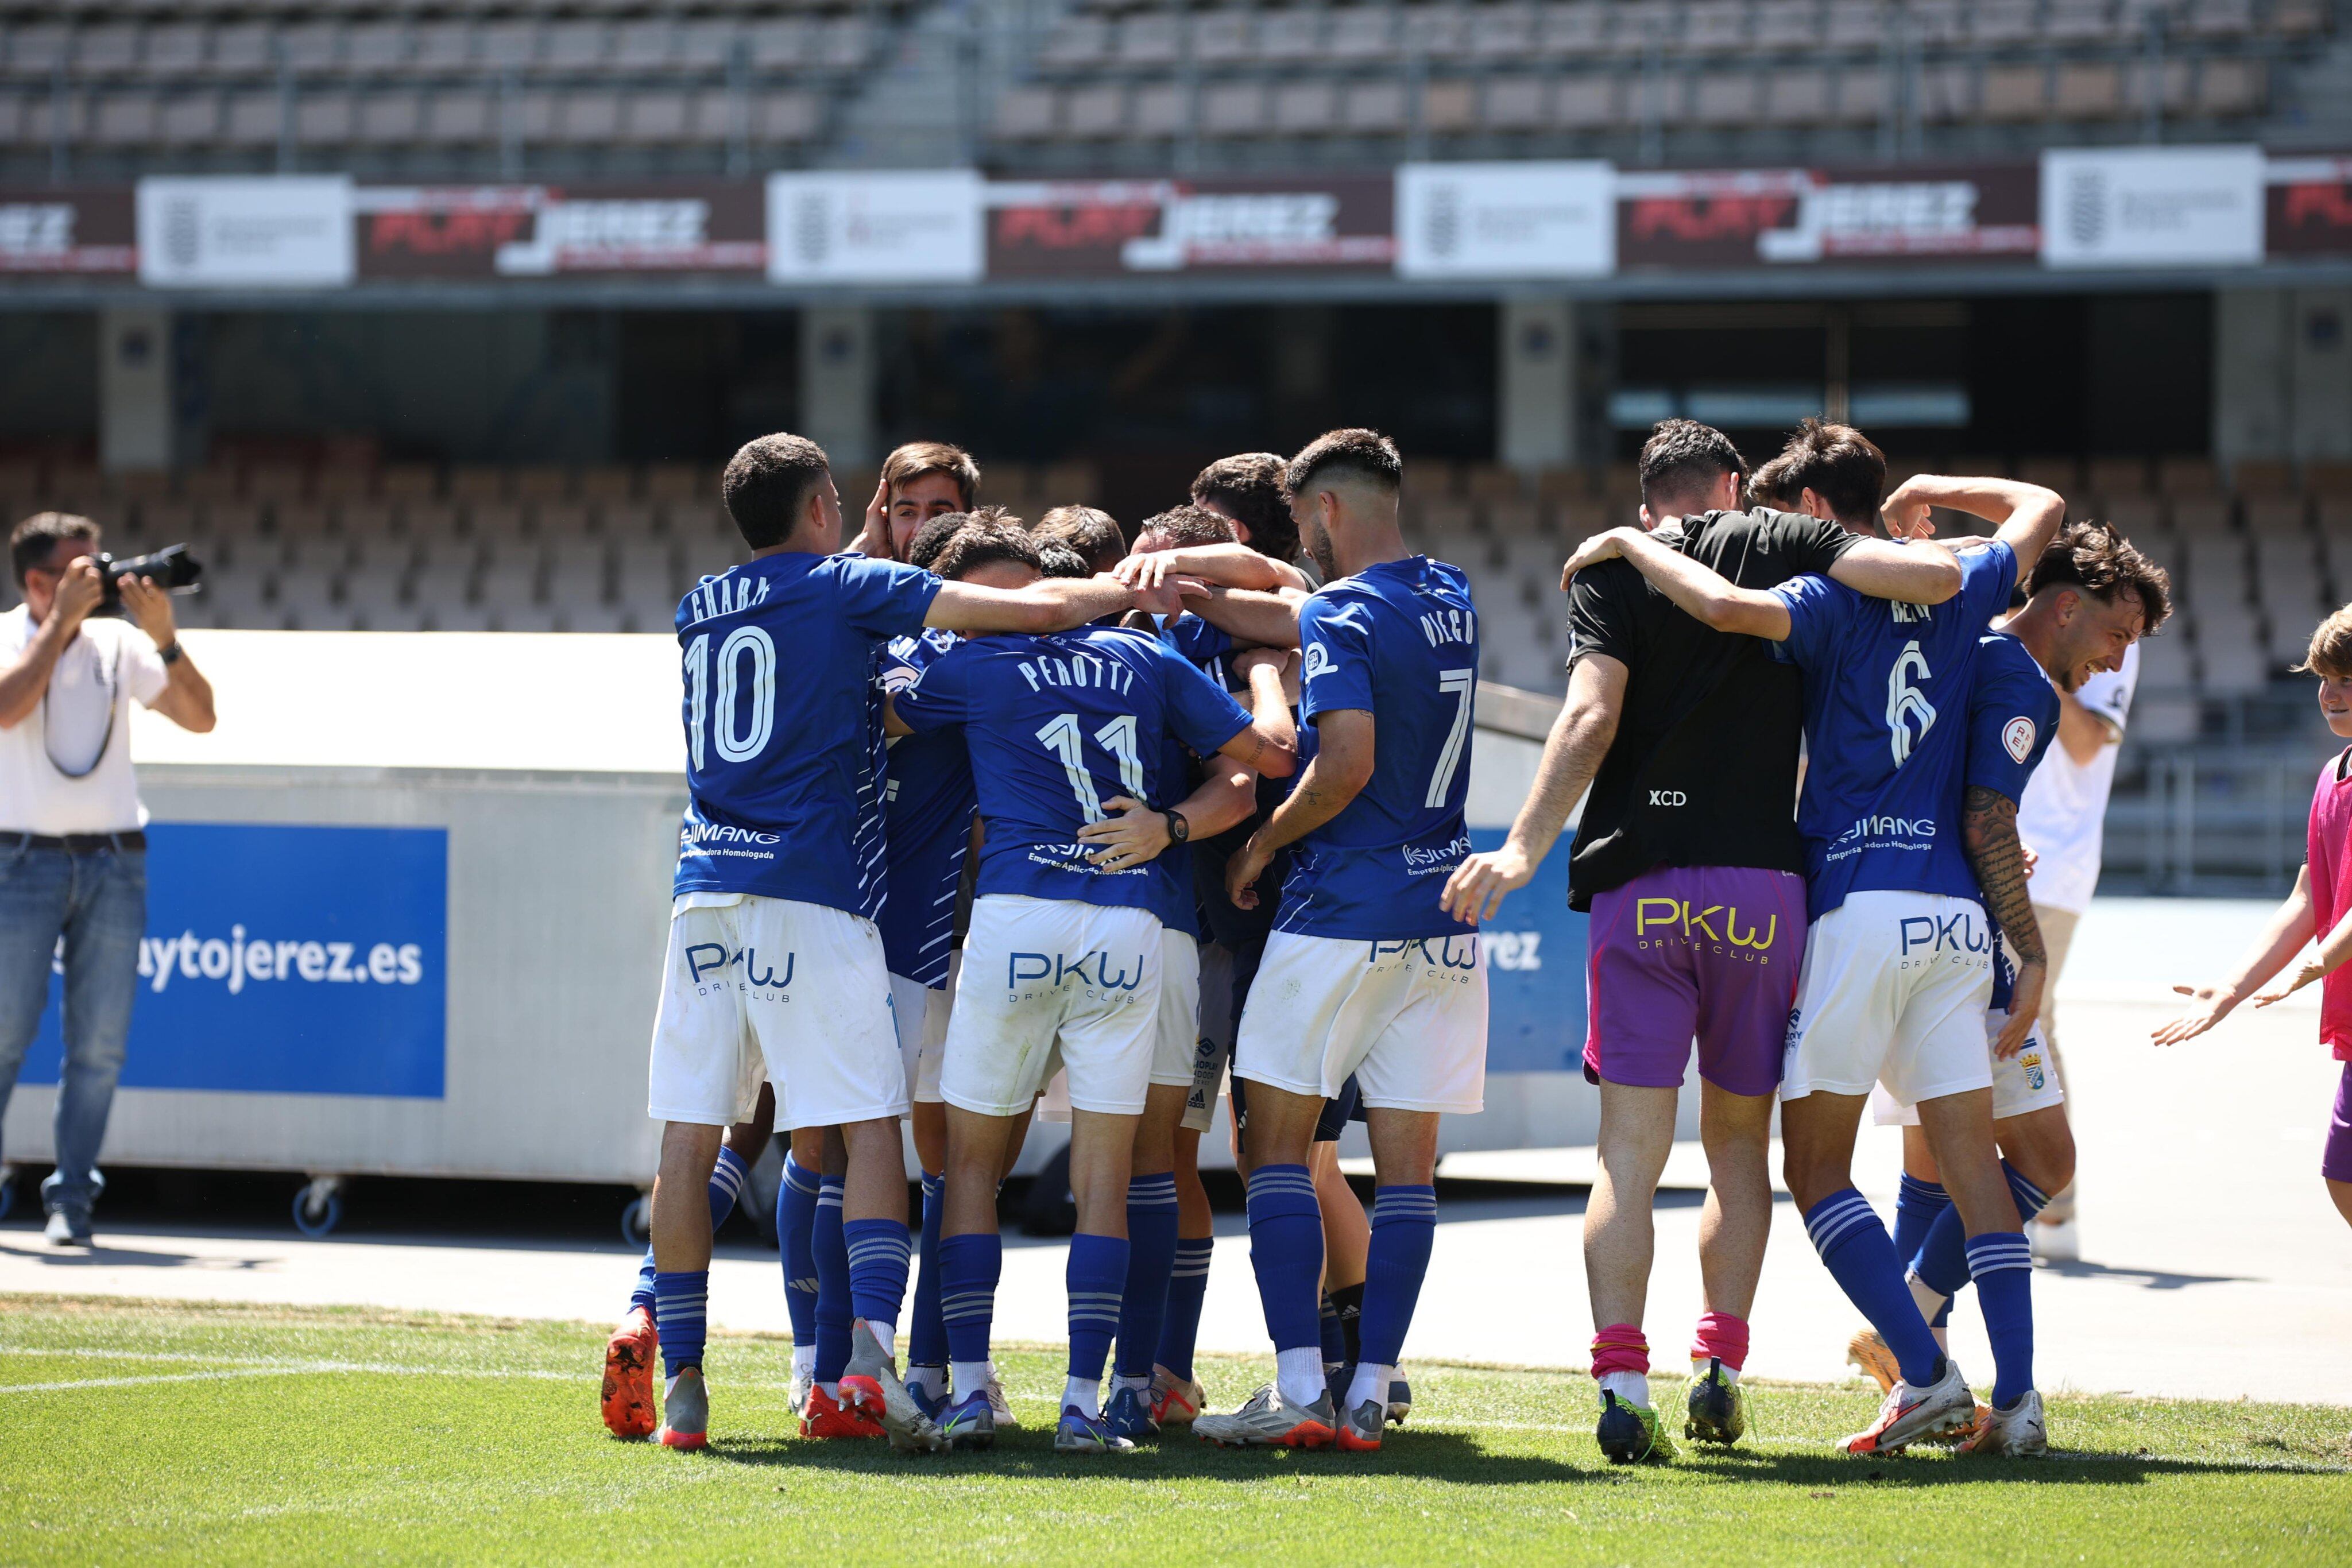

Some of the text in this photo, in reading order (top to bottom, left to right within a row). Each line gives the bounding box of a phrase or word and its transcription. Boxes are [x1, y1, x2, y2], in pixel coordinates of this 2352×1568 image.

[1419, 609, 1473, 648] DIEGO
[1018, 655, 1134, 696] PEROTTI
[684, 625, 776, 772] 10
[1885, 640, 1937, 769] 6
[1425, 668, 1472, 808] 7
[1035, 714, 1147, 823] 11
[1649, 790, 1686, 806] XCD
[722, 848, 774, 860] Homologada
[1827, 846, 1862, 861] Empresa
[1891, 841, 1933, 850] Homologa
[1407, 866, 1438, 876] Empresa
[1637, 897, 1777, 950] PKW
[1900, 913, 1993, 956] PKW
[685, 943, 795, 988] PW
[1009, 951, 1143, 990] PKW
[1369, 936, 1476, 970] PKW
[1639, 937, 1769, 965] DRIVE CLUB
[1952, 956, 1989, 969] CLUB
[698, 980, 790, 1002] DRIE LUB
[1009, 984, 1135, 1005] DRIVE CLUB
